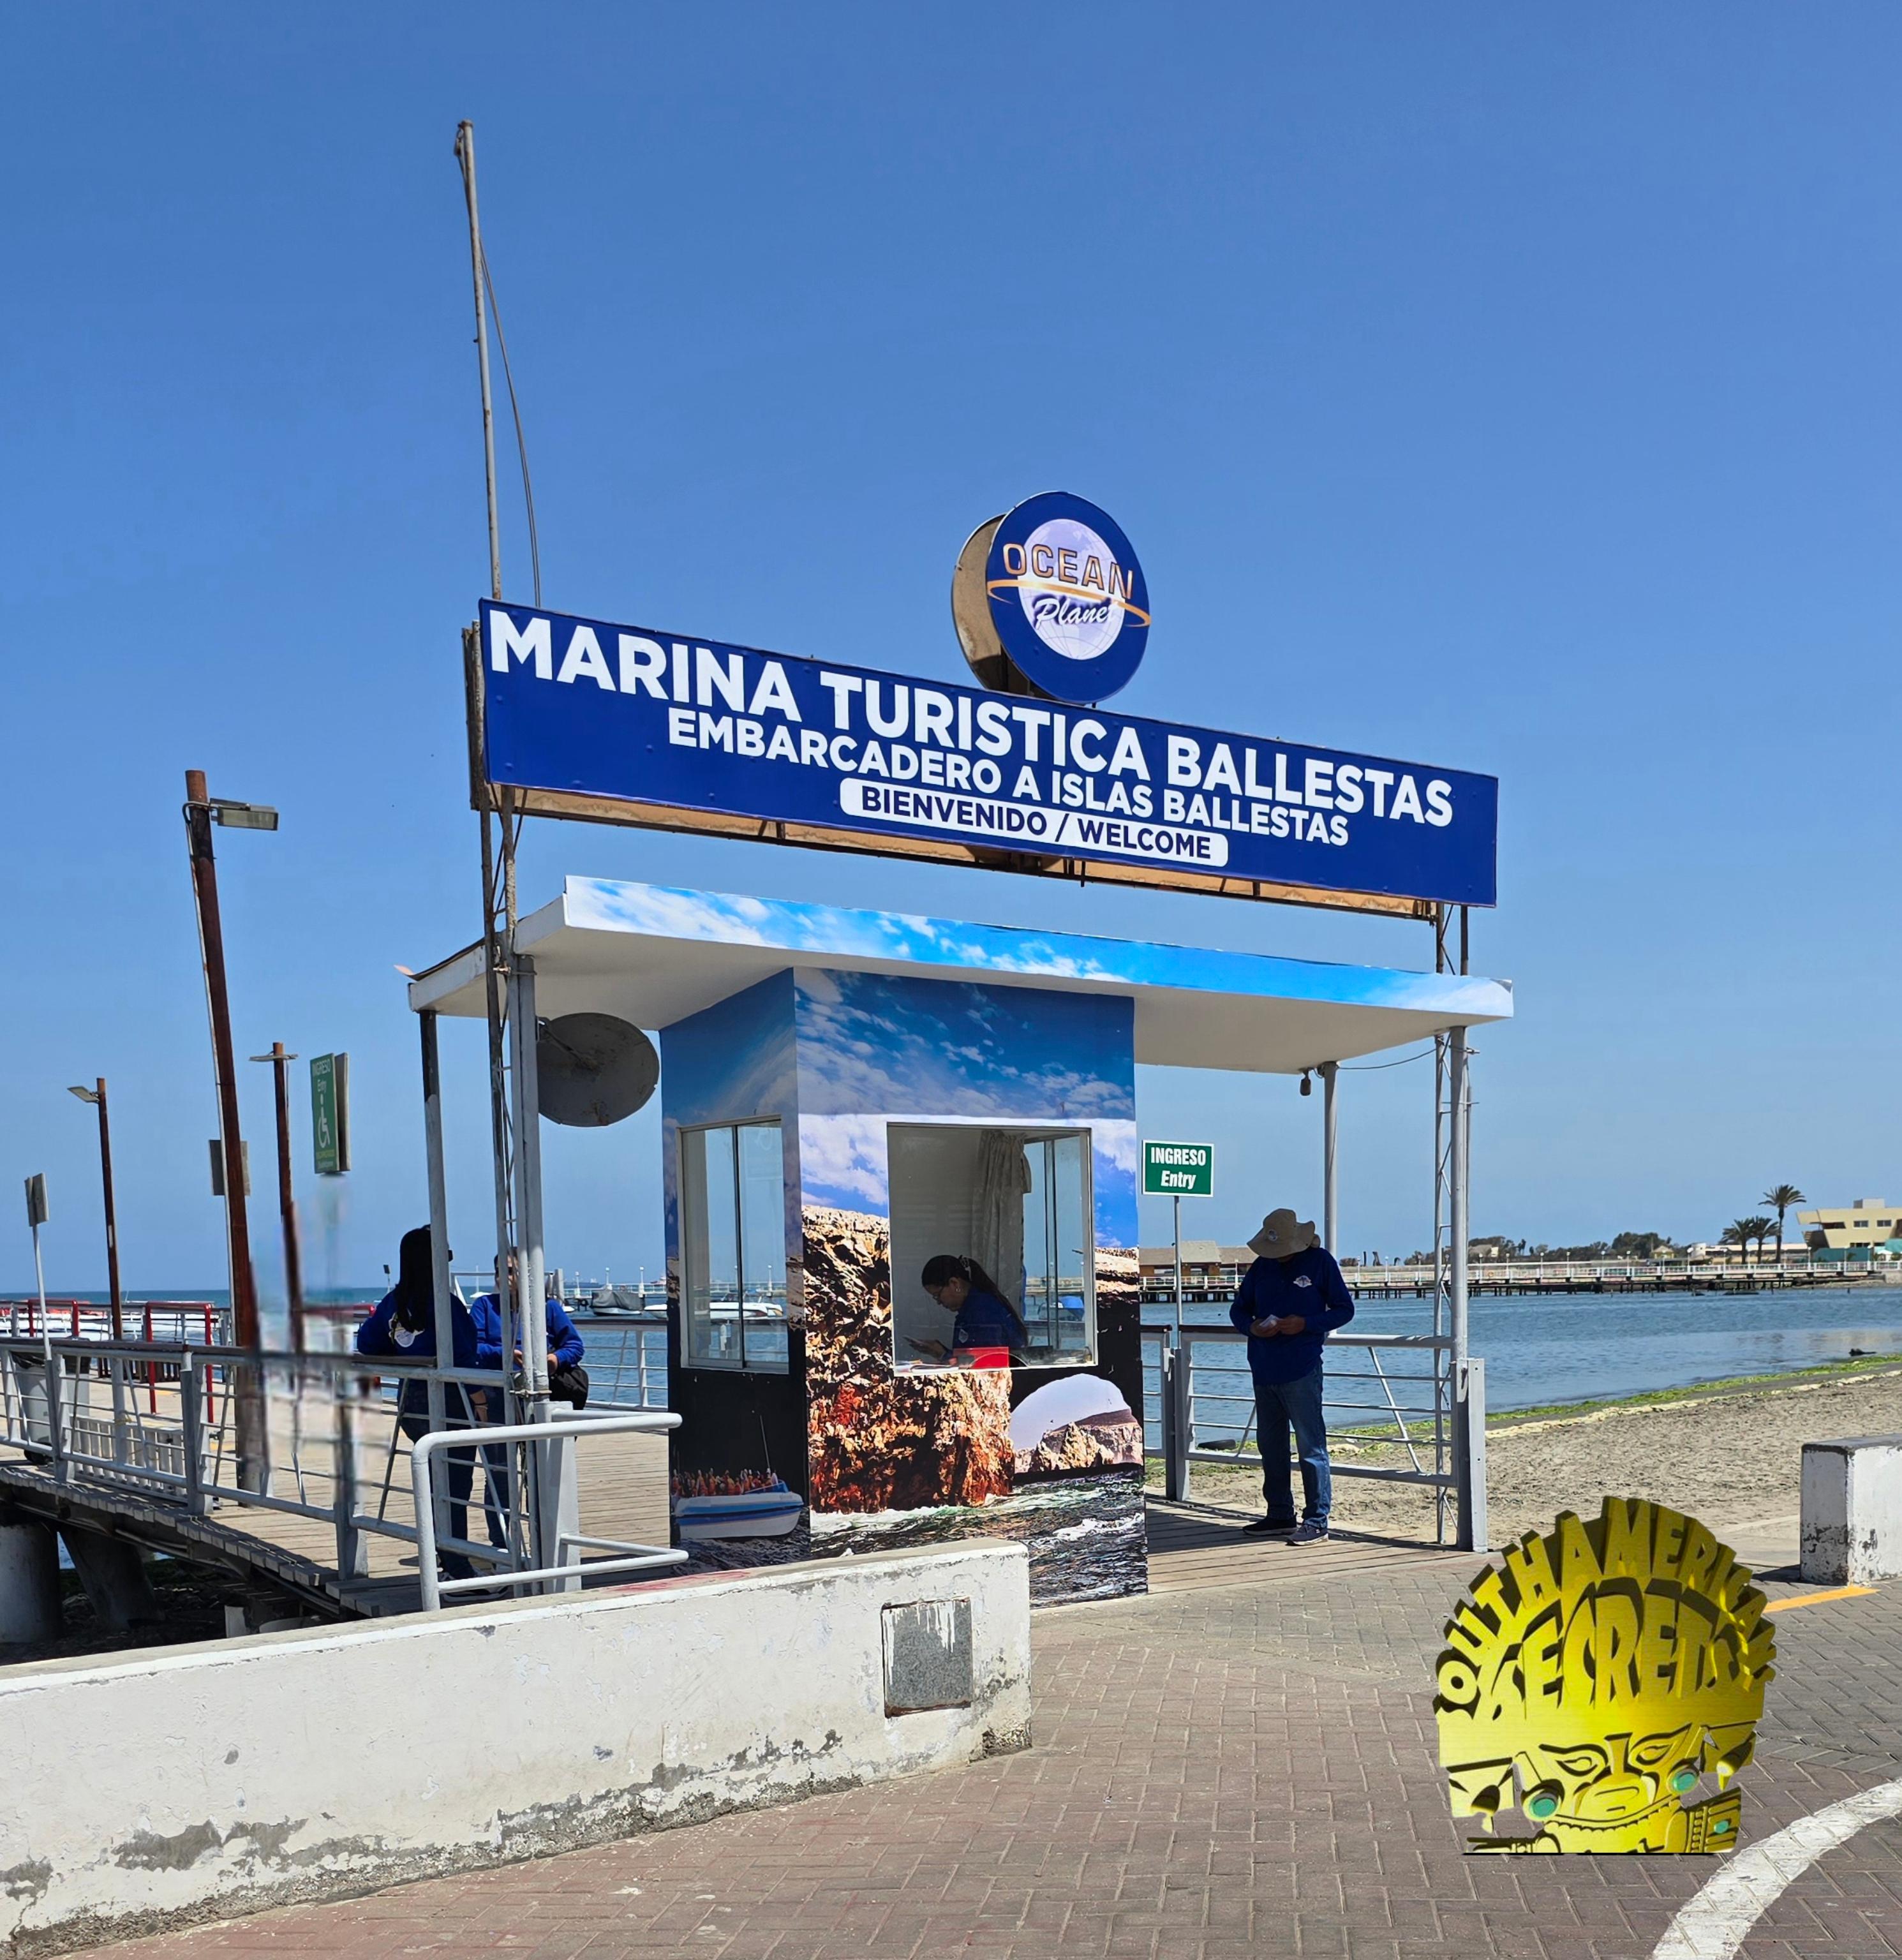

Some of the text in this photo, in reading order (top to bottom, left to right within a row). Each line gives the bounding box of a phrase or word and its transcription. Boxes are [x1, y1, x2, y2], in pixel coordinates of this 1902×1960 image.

[1002, 543, 1133, 600] OCEAN
[489, 610, 1453, 827] MARINA TURISTICA BALLESTAS
[669, 707, 1348, 846] EMBARCADERO A ISLAS BALLESTAS
[861, 785, 1210, 859] BIENVENIDO / WELCOME
[1150, 1147, 1207, 1166] INGRESO
[1161, 1169, 1196, 1190] Entry
